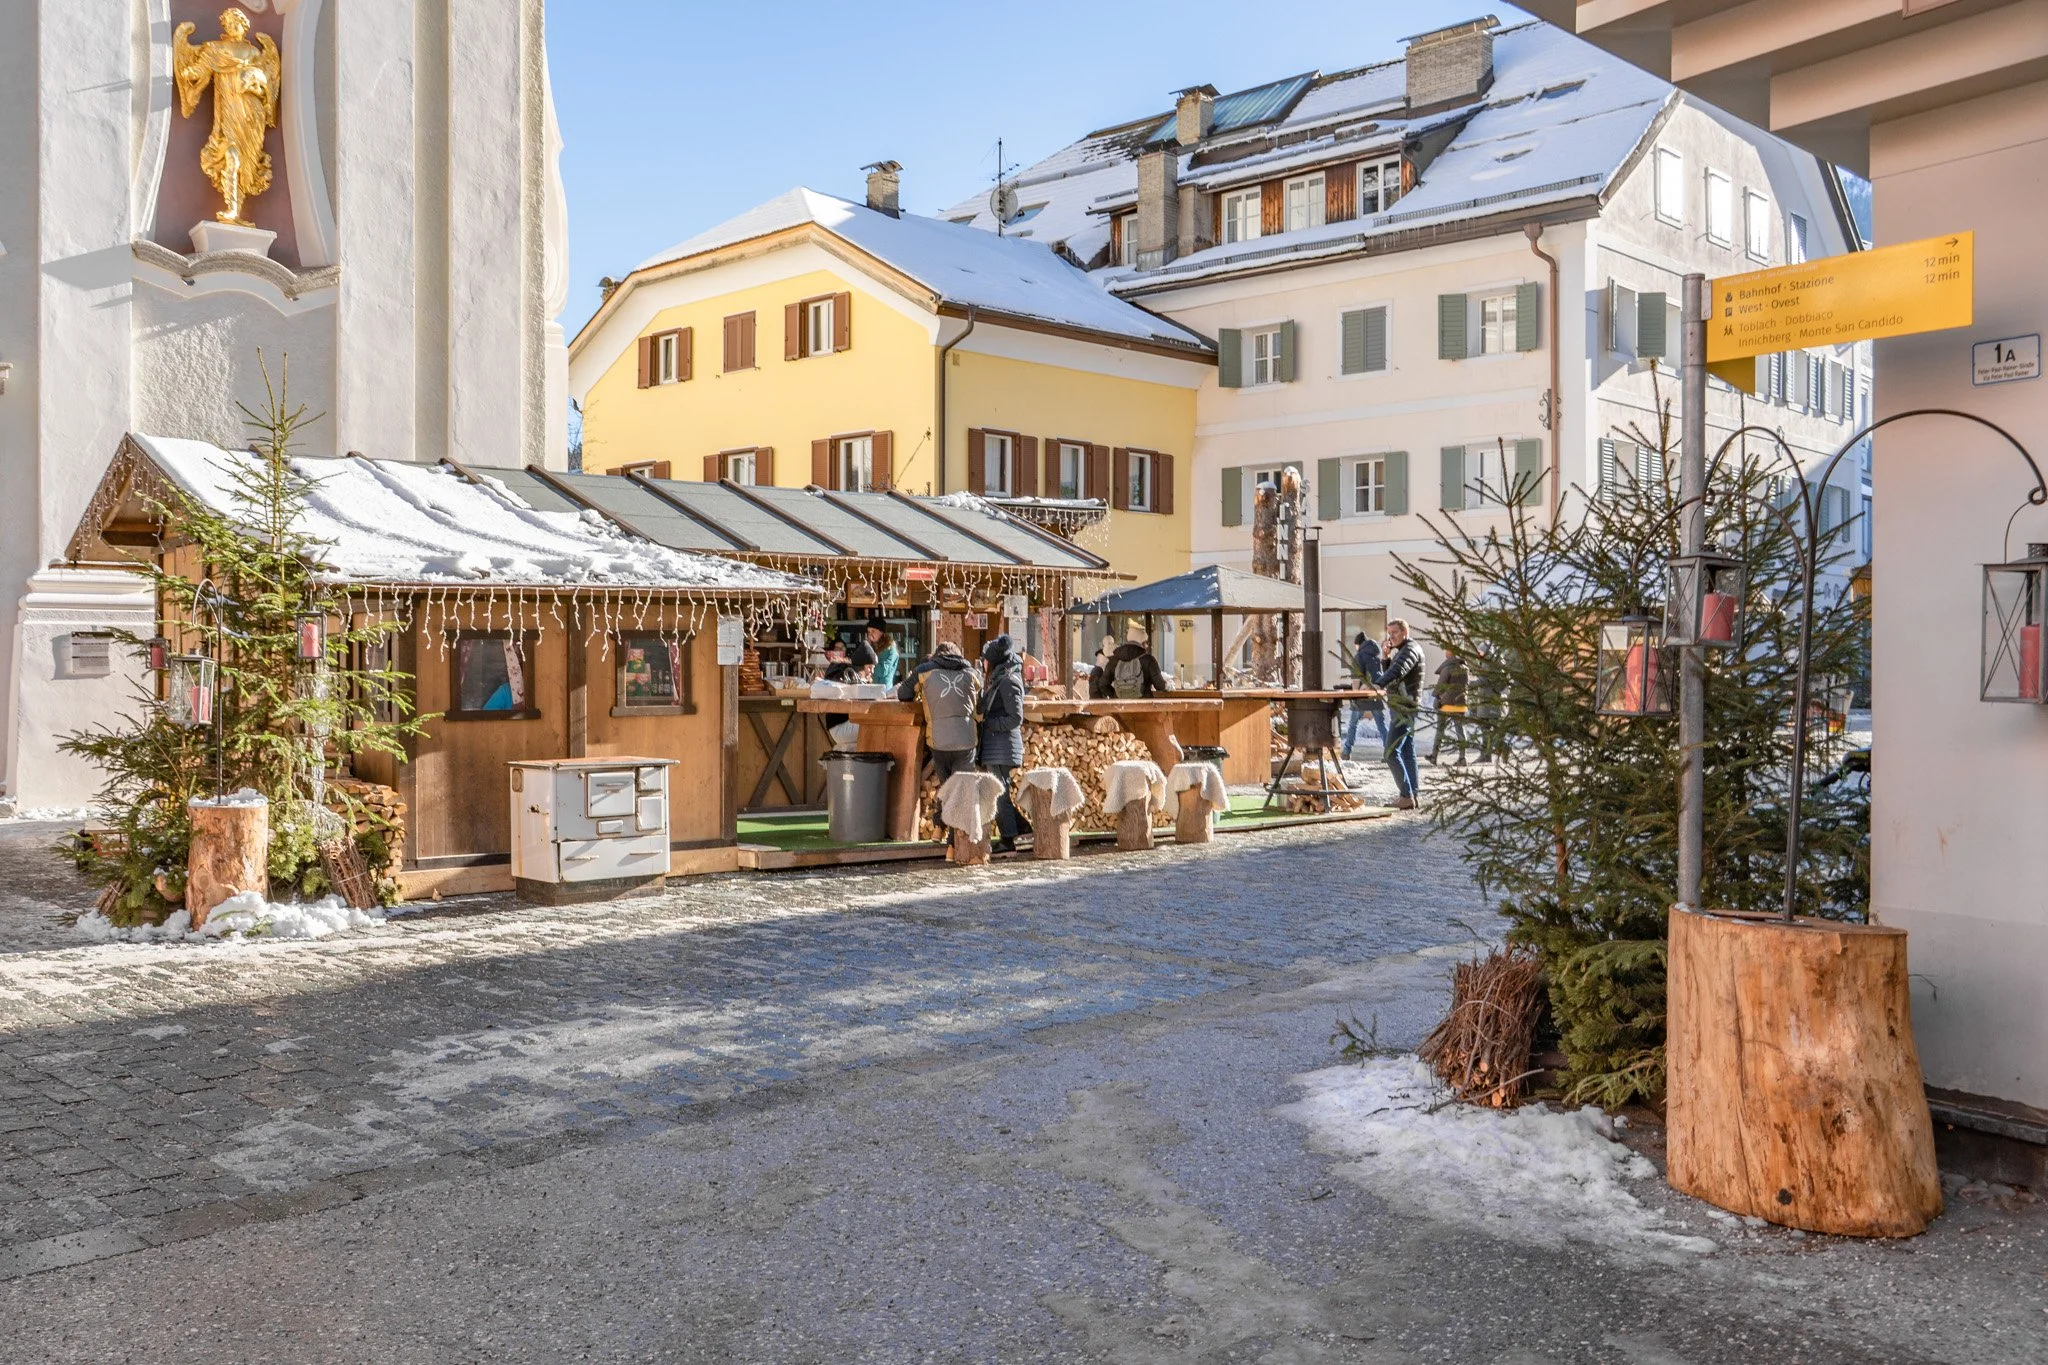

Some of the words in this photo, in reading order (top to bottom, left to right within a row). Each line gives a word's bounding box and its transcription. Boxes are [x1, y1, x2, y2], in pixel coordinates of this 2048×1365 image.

[1924, 256, 1936, 268] 12
[1937, 252, 1960, 265] min
[1739, 283, 1782, 299] Bahnhof
[1790, 275, 1835, 291] Stazione
[1924, 273, 1936, 284] 12
[1937, 269, 1960, 282] min
[1738, 302, 1763, 315] West
[1771, 296, 1800, 310] Ovest
[1738, 319, 1776, 333] Toblach
[1785, 310, 1833, 326] Dobbiaco
[1738, 331, 1792, 348] Innichberg
[1800, 326, 1832, 338] Monte
[1835, 322, 1855, 334] San
[1858, 314, 1904, 330] Candido
